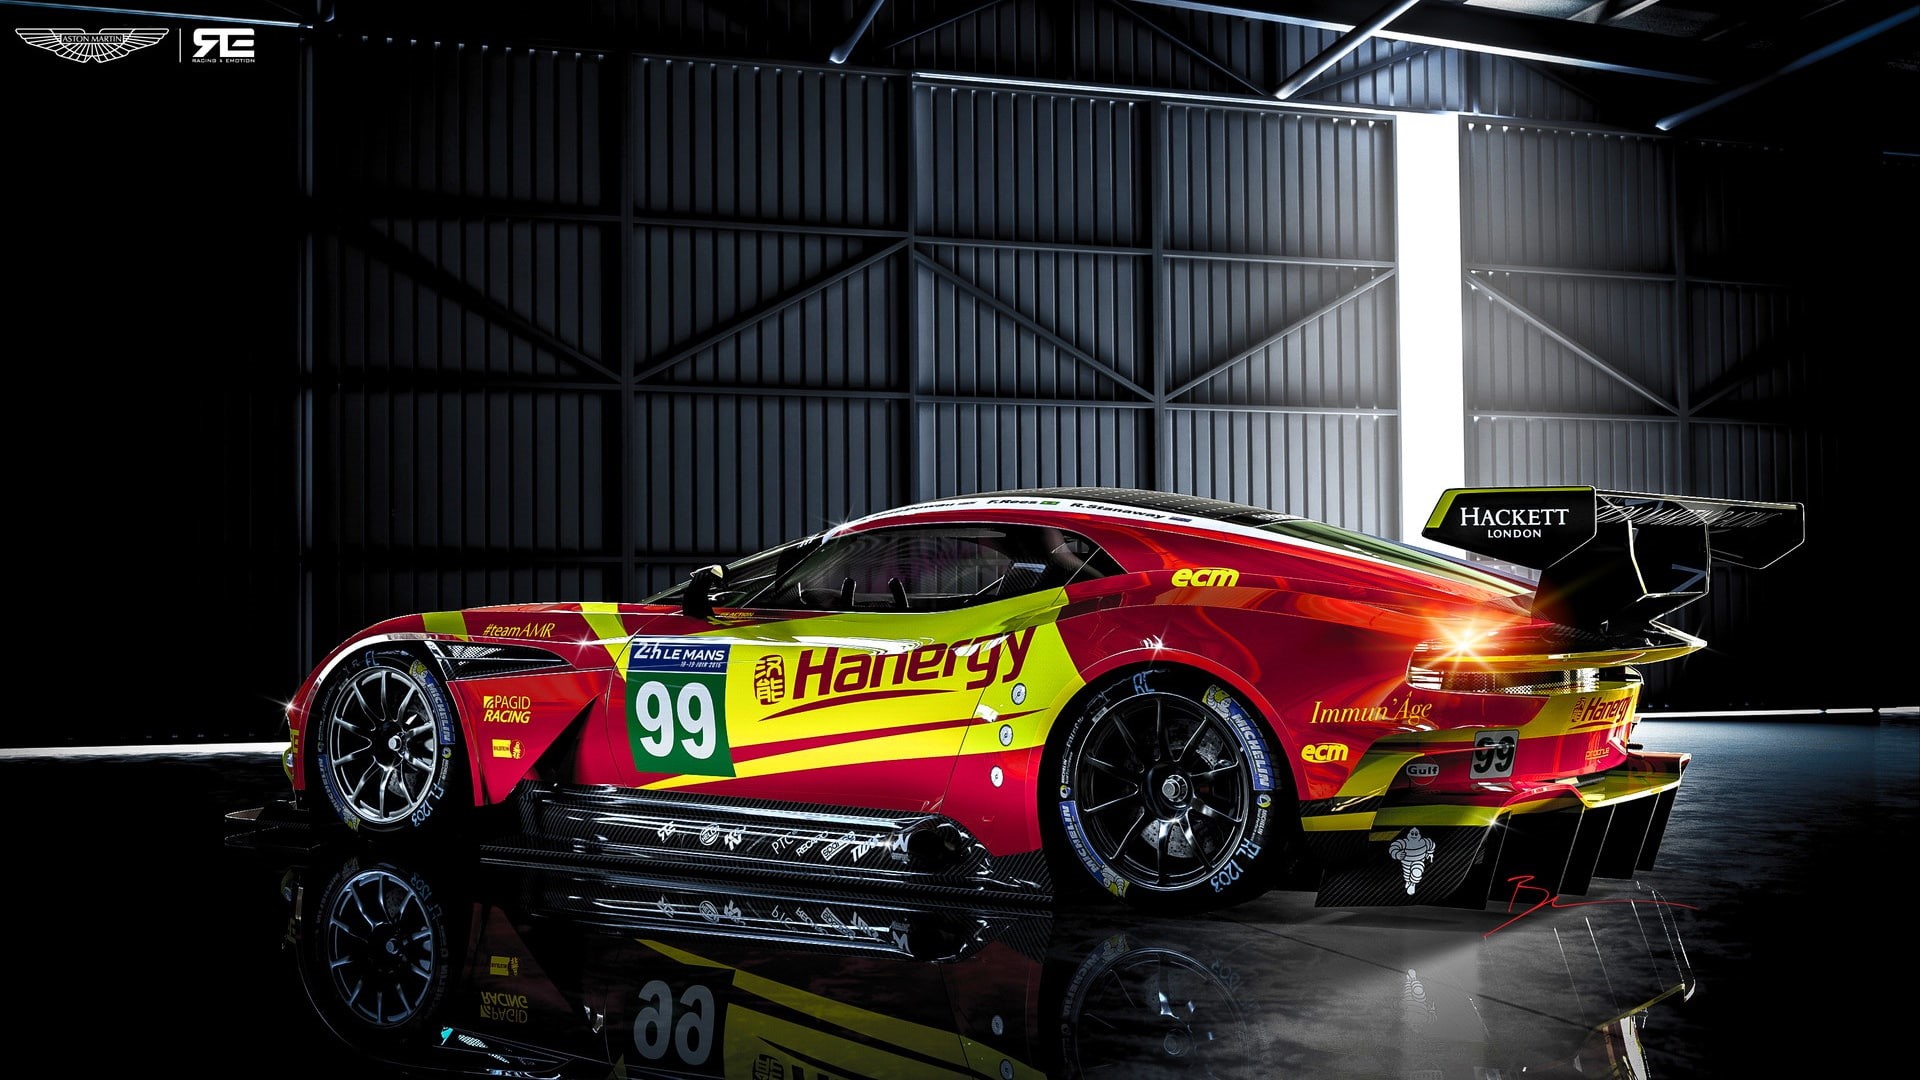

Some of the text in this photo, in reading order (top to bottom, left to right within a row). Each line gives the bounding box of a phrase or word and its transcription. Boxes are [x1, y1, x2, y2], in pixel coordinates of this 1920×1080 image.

[1070, 502, 1166, 520] R.Stanaway
[1460, 507, 1569, 527] HACKETT
[1487, 529, 1542, 539] LONDON
[1172, 568, 1240, 588] ecm
[483, 623, 556, 638] #teamAMR
[634, 642, 725, 661] 24h LE MANS
[793, 626, 1038, 700] Hanergy
[495, 695, 531, 710] PAGID
[428, 683, 451, 743] MICHELIN
[483, 709, 531, 723] RACING
[635, 680, 717, 760] 99
[1231, 713, 1270, 787] MICHELIN
[1301, 743, 1349, 763] ecm
[1473, 736, 1515, 774] 99
[1408, 765, 1438, 774] Gulf
[411, 799, 434, 827] 1203
[1257, 808, 1268, 835] MICHELIN
[1062, 805, 1100, 873] MICHELIN
[1210, 859, 1244, 892] 1203
